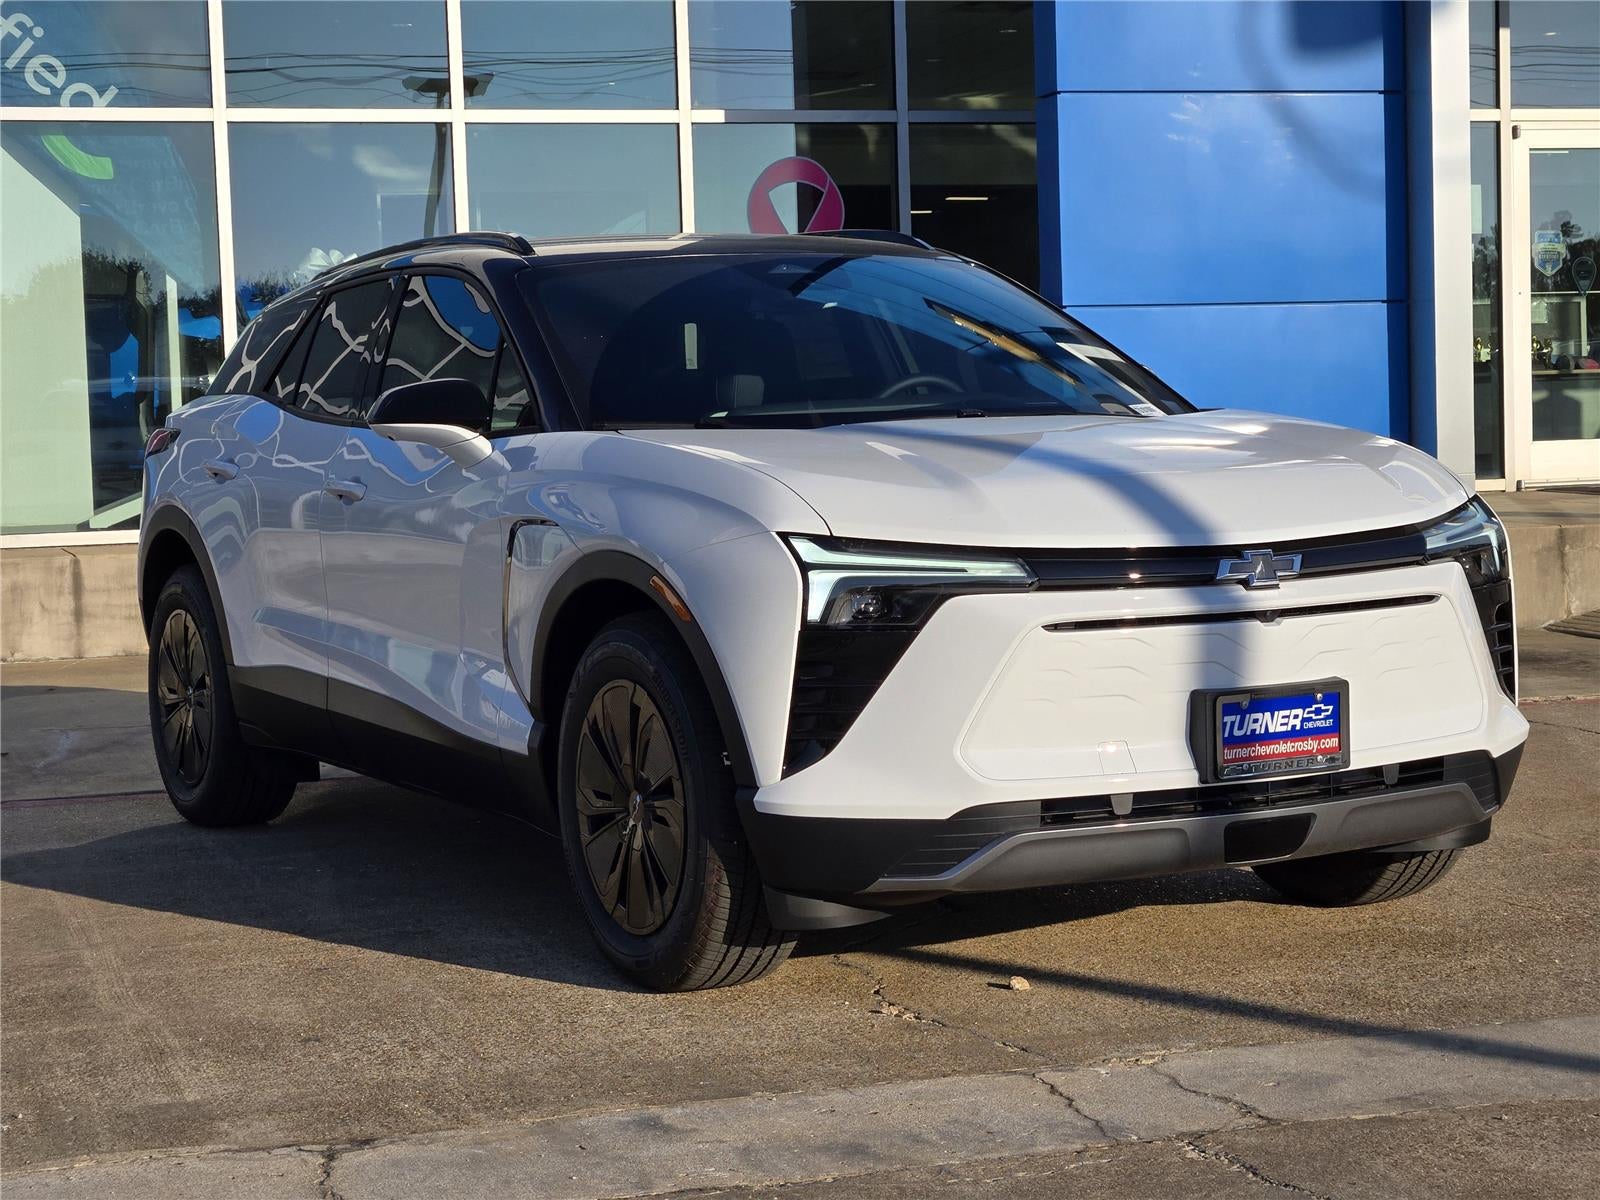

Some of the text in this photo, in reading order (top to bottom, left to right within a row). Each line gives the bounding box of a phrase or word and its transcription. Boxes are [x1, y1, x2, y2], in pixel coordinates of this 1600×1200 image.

[1223, 708, 1303, 738] TURNER
[1303, 719, 1333, 729] CHEVROLET
[1223, 737, 1338, 760] turnerchevroletcrosby.com
[1251, 758, 1315, 773] TURNER
